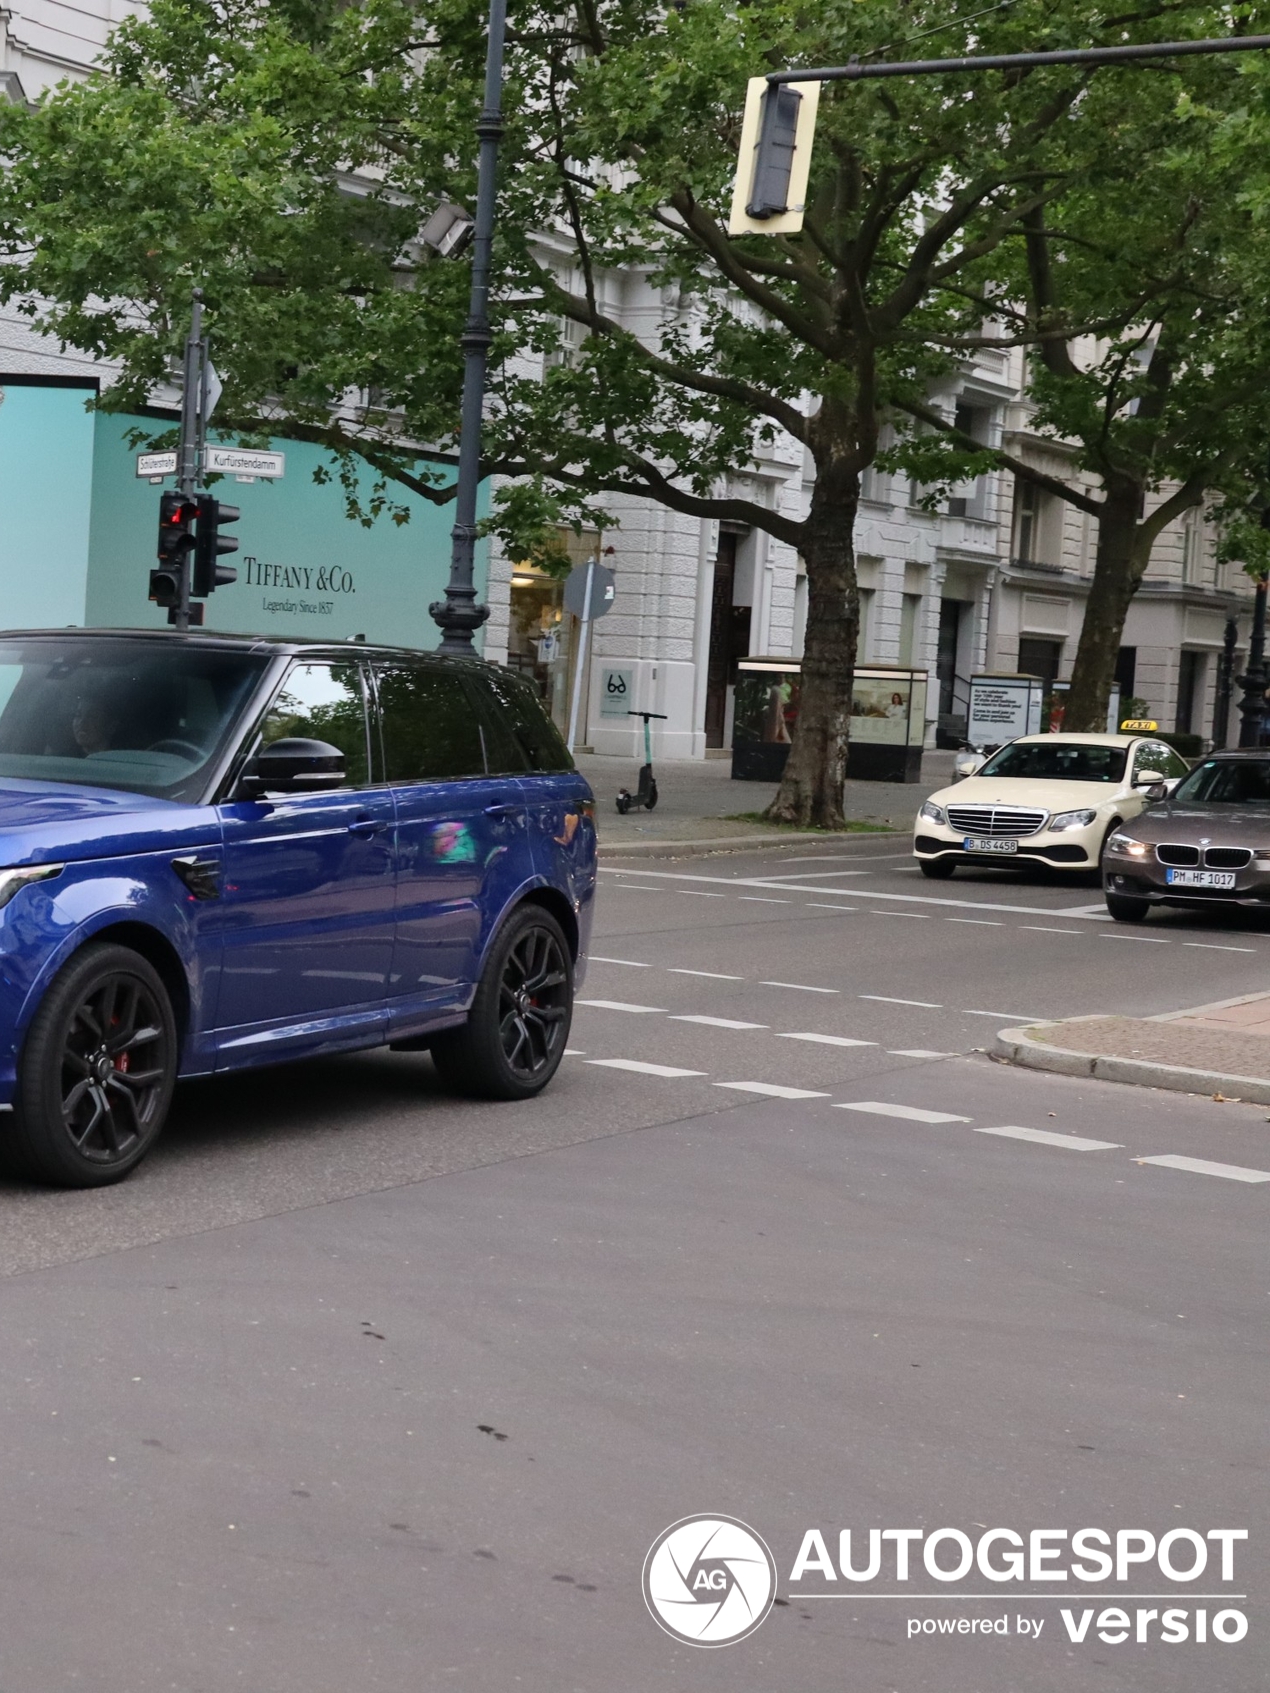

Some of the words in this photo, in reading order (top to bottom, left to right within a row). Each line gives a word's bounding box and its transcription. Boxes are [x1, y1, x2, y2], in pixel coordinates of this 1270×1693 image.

[139, 455, 175, 470] Schlüterstraße
[213, 454, 276, 470] Kurfürstendamm
[243, 556, 314, 589] TIFFANY
[262, 597, 297, 615] Legendary
[299, 600, 317, 614] Since
[318, 601, 334, 615] 1837
[1125, 720, 1151, 730] TAXI
[968, 839, 975, 850] B
[980, 840, 992, 851] DS
[992, 840, 1016, 851] 4458
[1172, 870, 1186, 882] PM
[1192, 872, 1205, 884] HF
[1207, 872, 1234, 886] 1017
